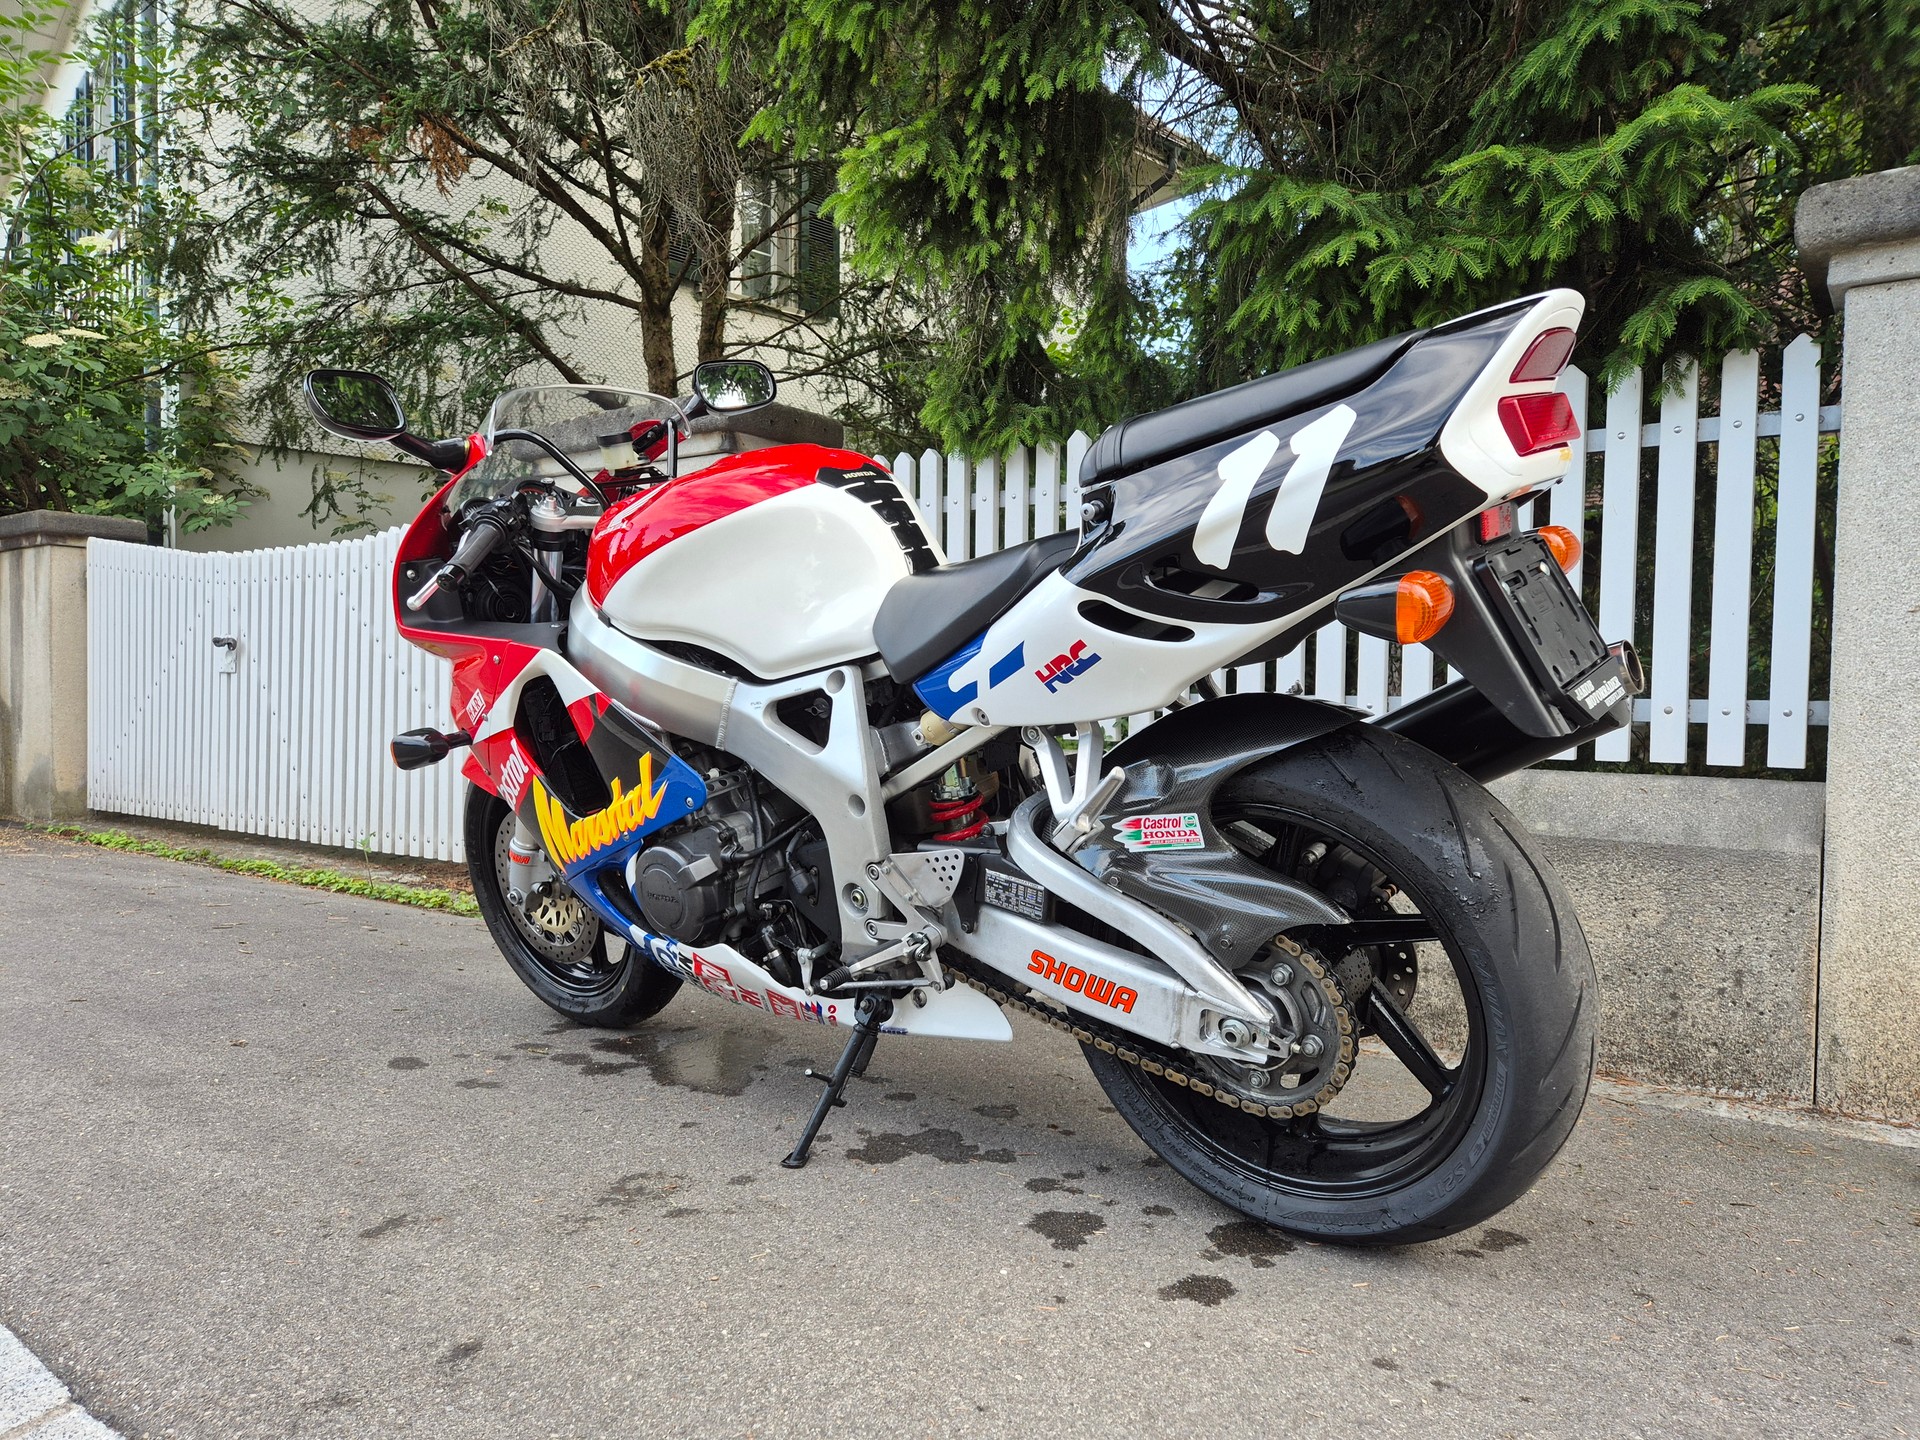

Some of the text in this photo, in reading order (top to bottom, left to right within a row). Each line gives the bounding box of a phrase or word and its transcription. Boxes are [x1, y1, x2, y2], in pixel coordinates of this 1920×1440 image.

[843, 471, 876, 479] HONDA
[1192, 404, 1357, 570] 11
[1034, 639, 1102, 694] HRC
[466, 690, 485, 721] HART
[498, 738, 529, 808] astrol
[533, 751, 669, 875] Marshal
[1143, 817, 1181, 830] Castrol
[1143, 830, 1199, 838] HONDA
[1027, 949, 1138, 1014] SHOWA
